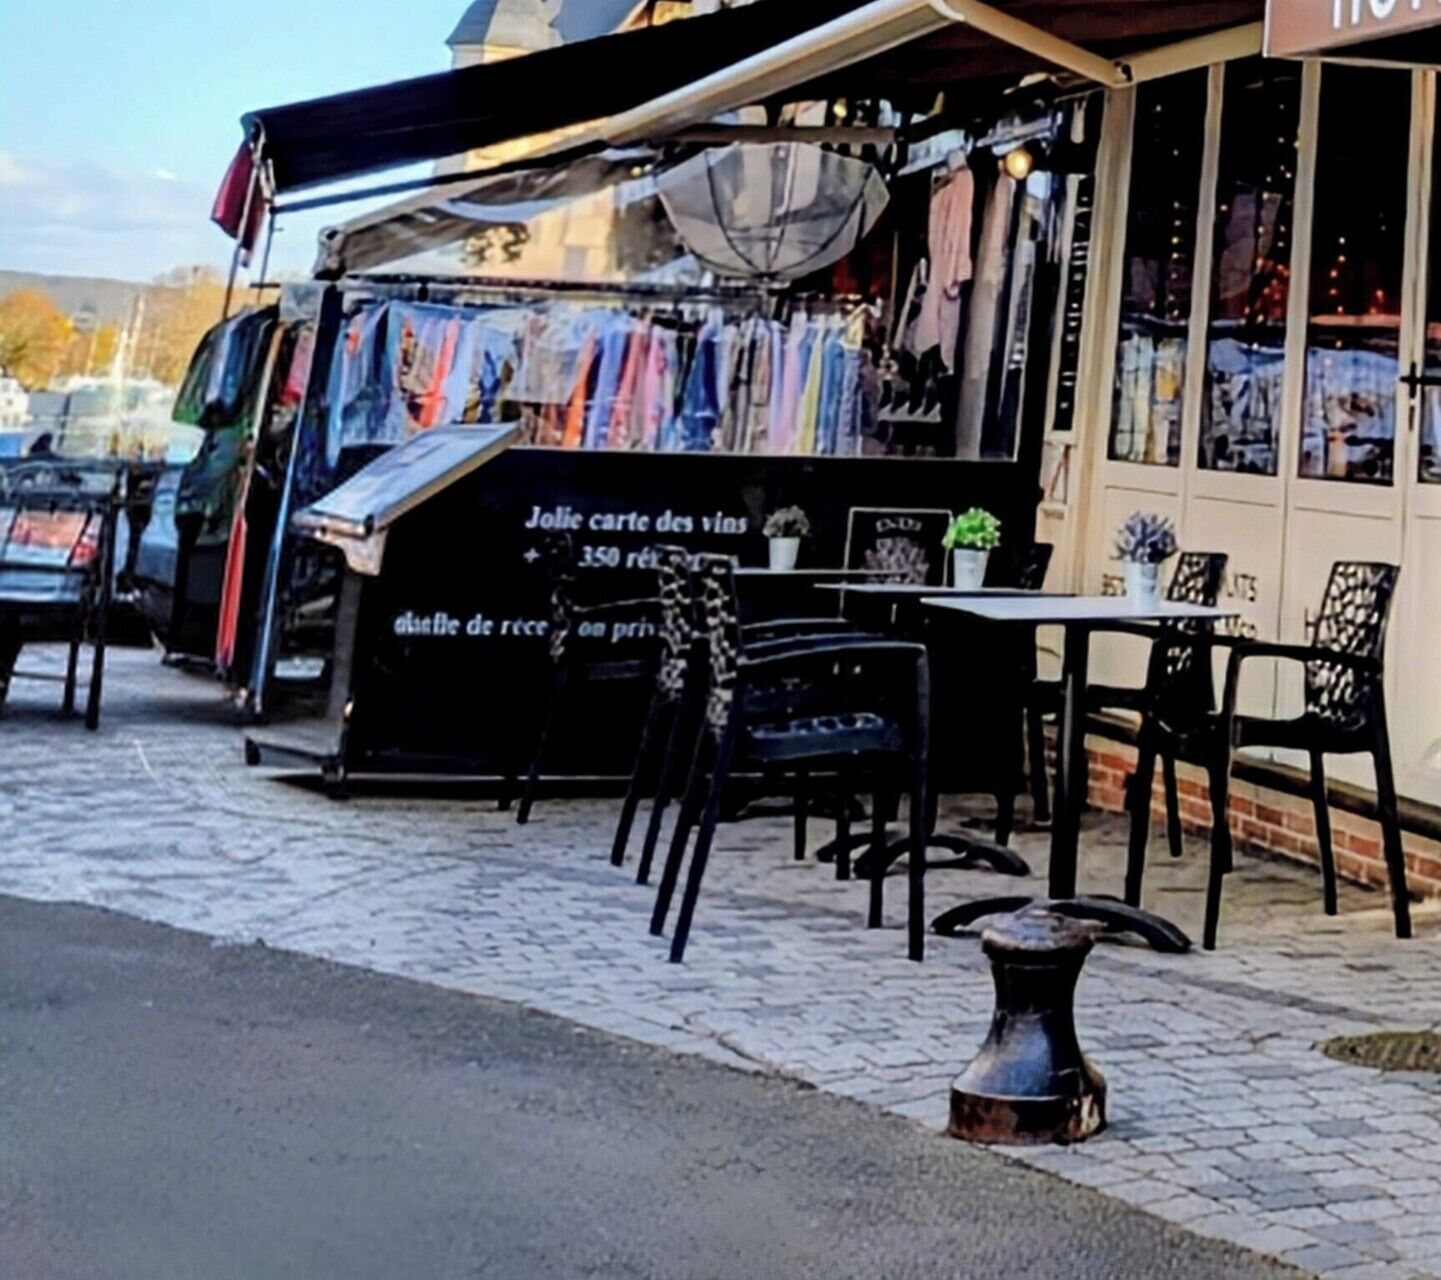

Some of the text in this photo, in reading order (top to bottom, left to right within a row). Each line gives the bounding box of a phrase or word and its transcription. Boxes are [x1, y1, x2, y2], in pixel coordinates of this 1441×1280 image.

[525, 505, 748, 534] Jolie carte des vins
[578, 545, 620, 568] 350
[466, 613, 494, 636] de
